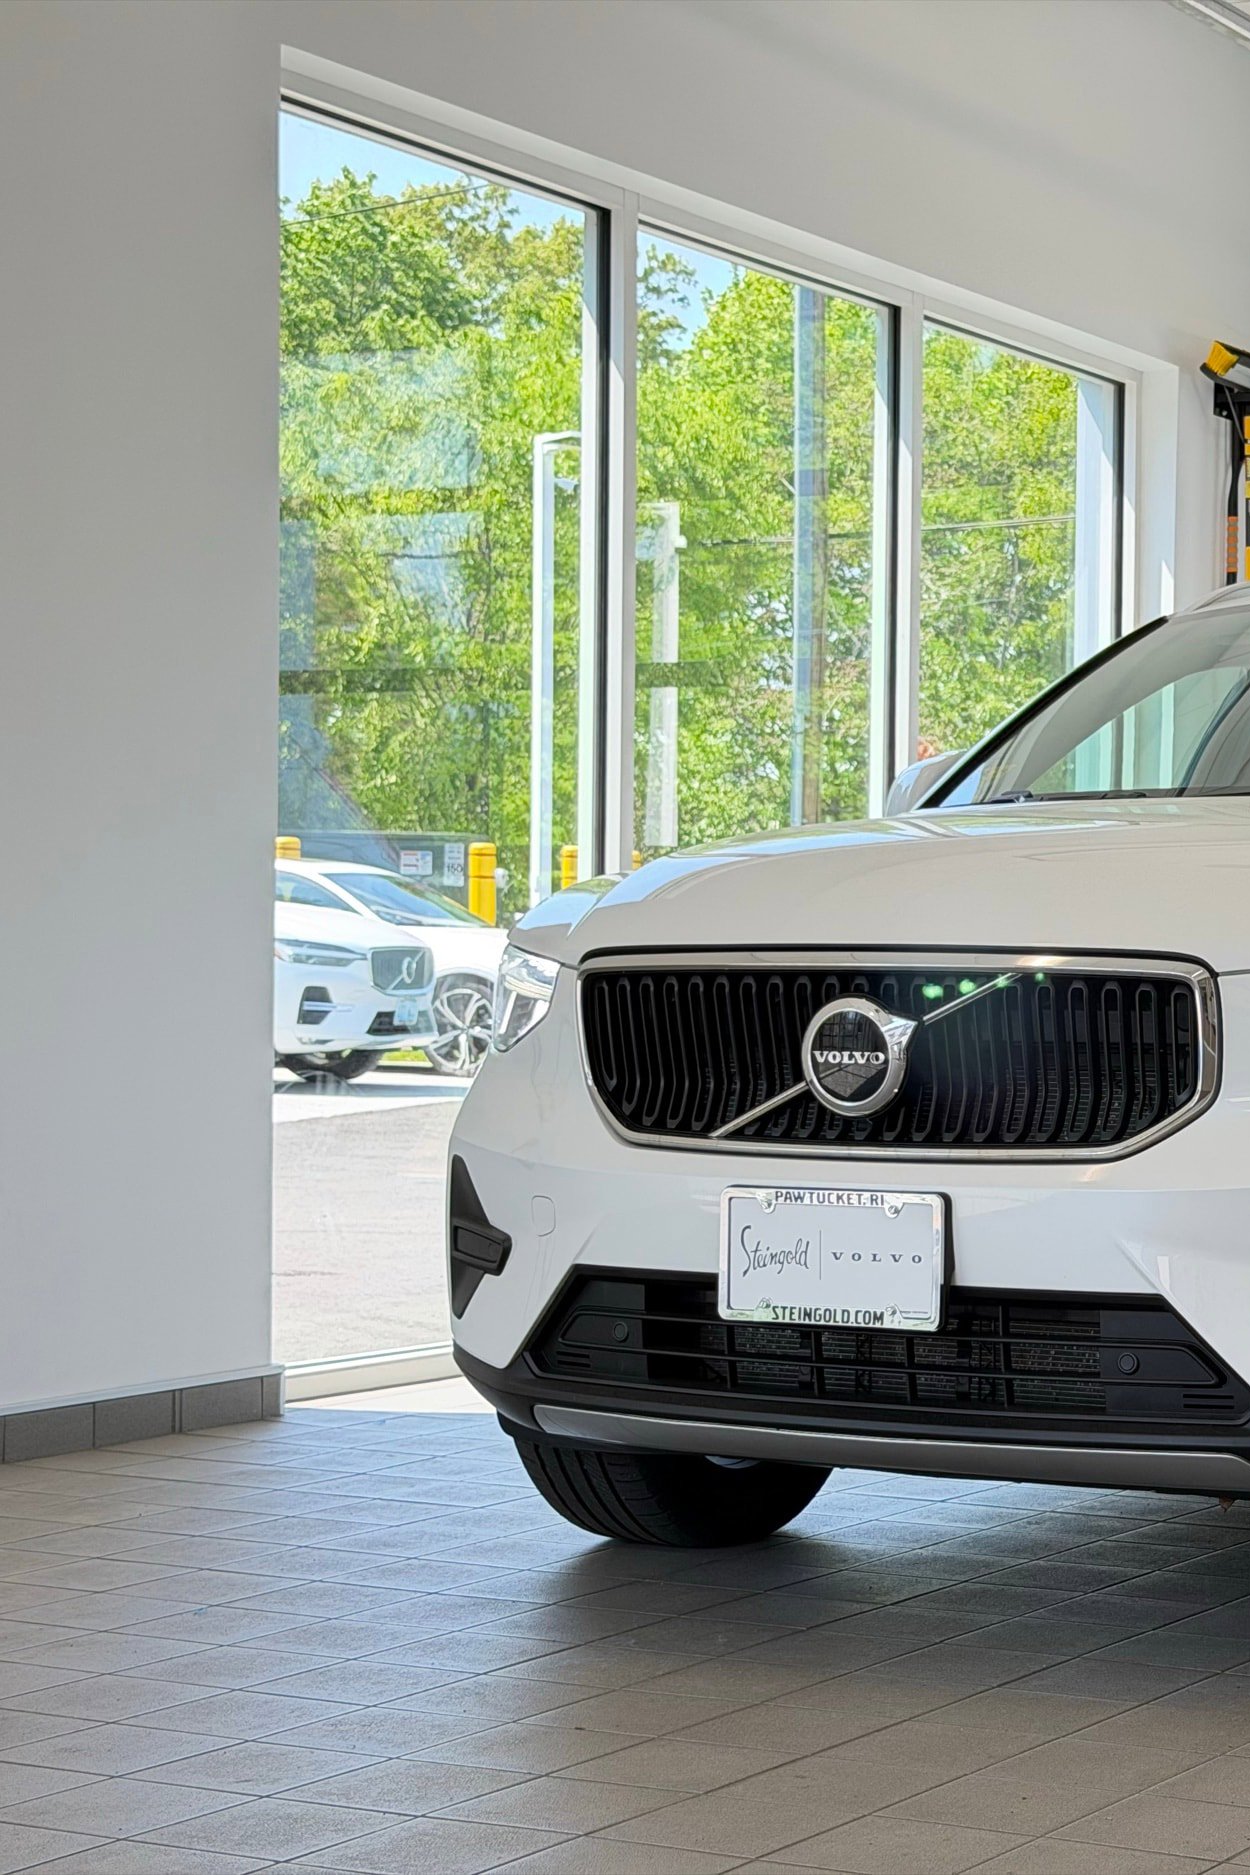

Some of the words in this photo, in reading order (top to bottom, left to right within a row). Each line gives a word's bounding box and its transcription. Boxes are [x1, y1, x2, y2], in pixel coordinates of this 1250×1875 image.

[812, 1050, 886, 1065] VOLVO
[869, 1193, 885, 1206] RI
[740, 1224, 811, 1278] Steingold
[831, 1251, 923, 1265] VOLVO
[771, 1305, 885, 1326] STEINGOLD.COM
